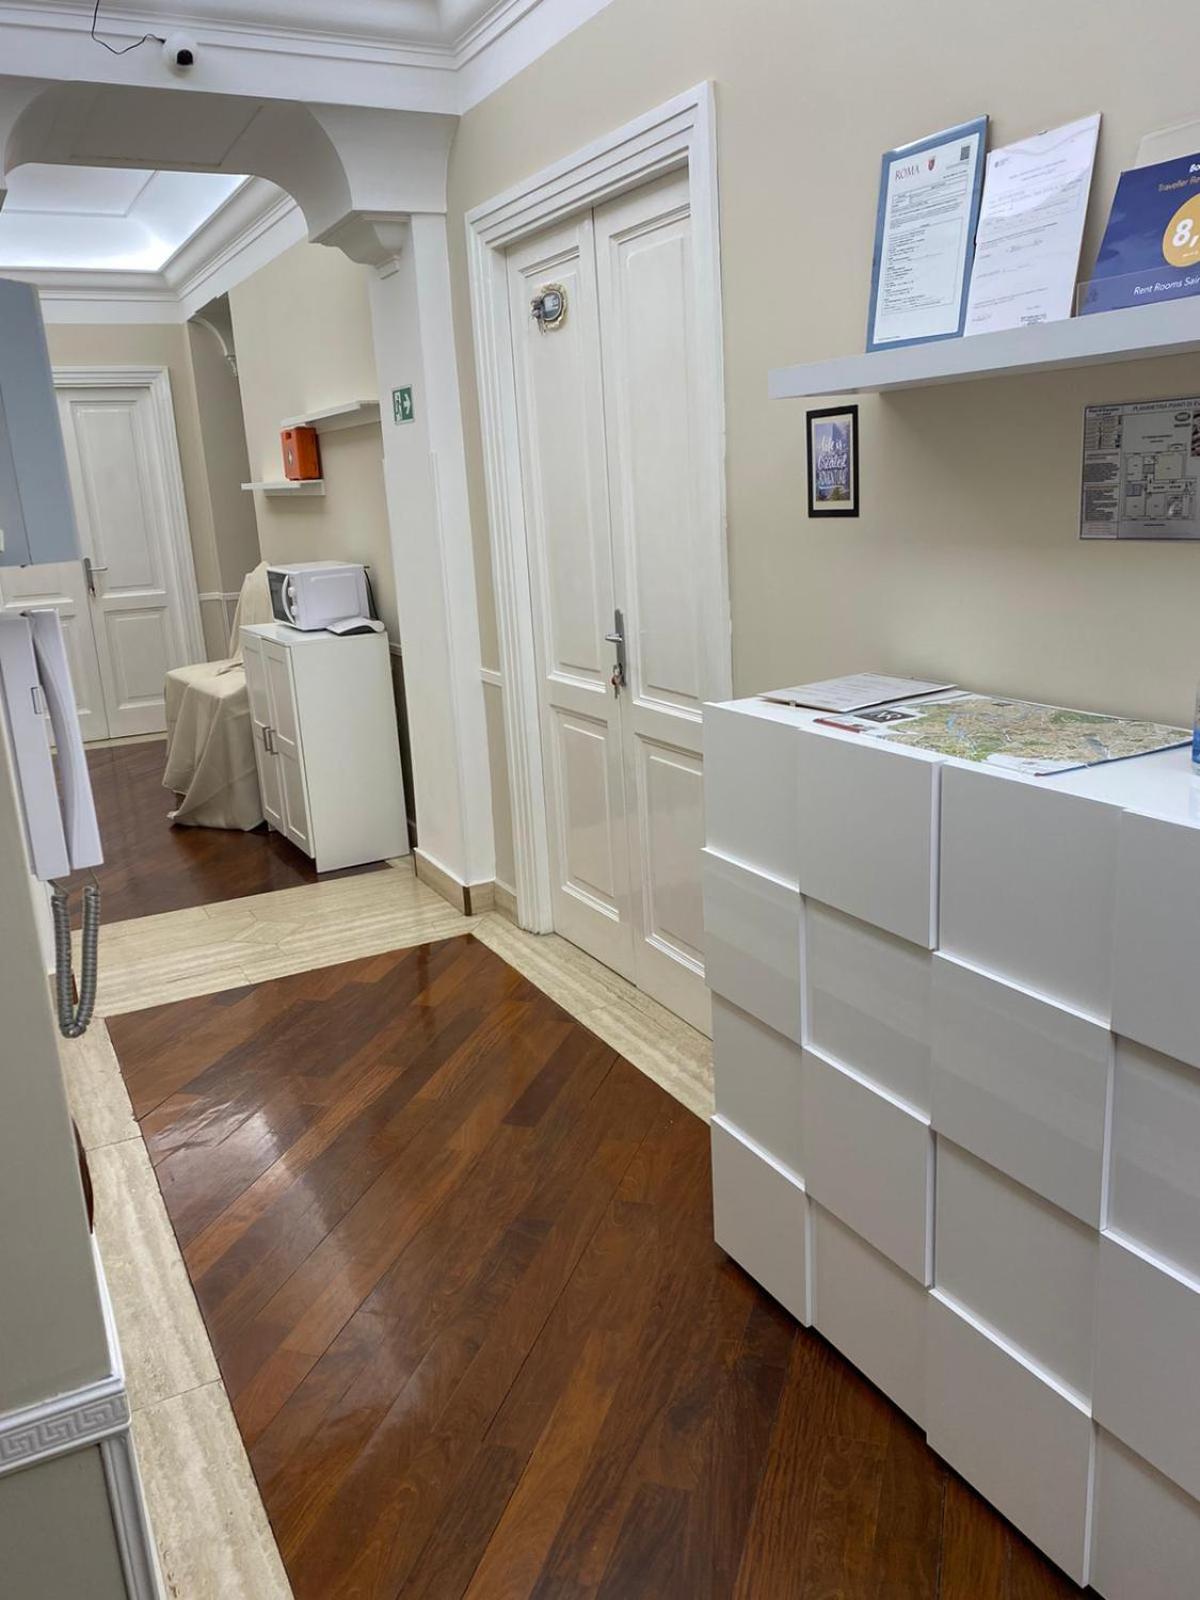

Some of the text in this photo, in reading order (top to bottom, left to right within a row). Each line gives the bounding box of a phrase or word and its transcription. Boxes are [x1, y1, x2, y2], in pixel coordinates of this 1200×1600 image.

[895, 165, 920, 181] ROMA
[1133, 284, 1153, 296] Rent
[1153, 280, 1183, 293] Rooms
